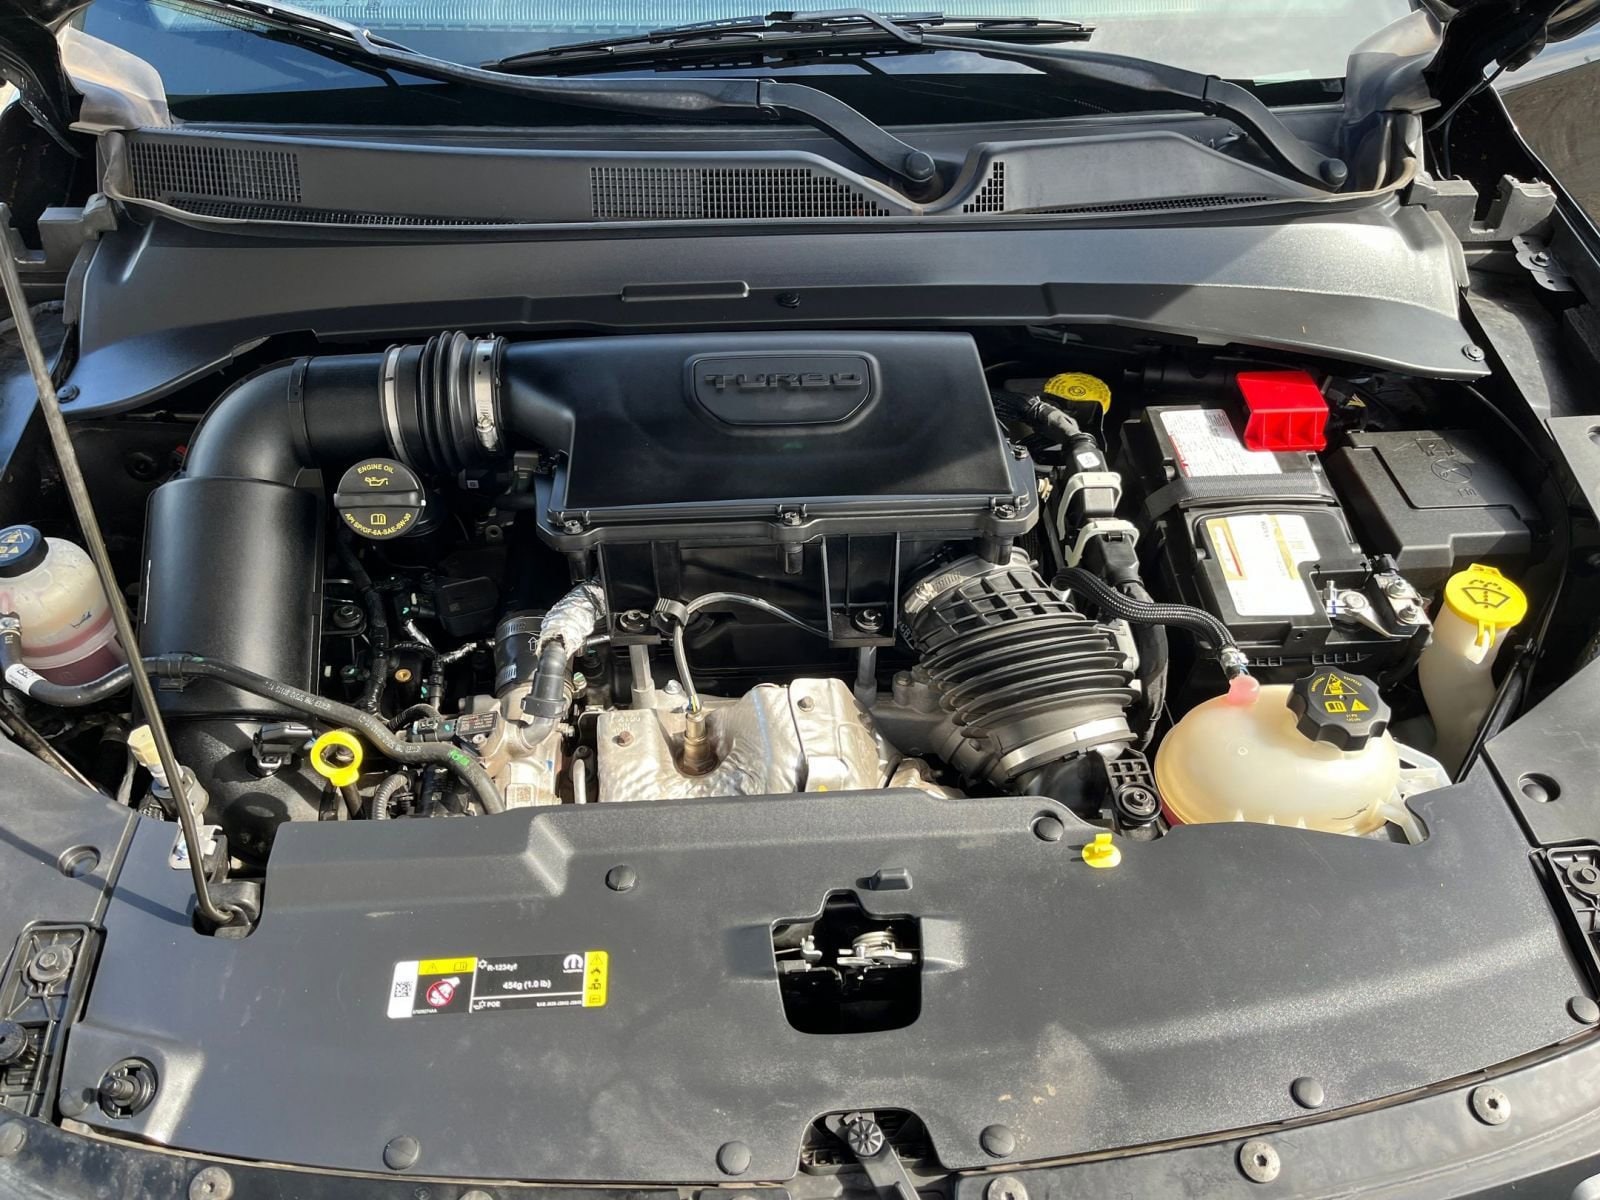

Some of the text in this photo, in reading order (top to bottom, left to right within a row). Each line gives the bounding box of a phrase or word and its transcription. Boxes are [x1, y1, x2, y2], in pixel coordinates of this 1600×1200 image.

[704, 372, 862, 389] TURBO
[357, 464, 394, 474] ENGINE OIL
